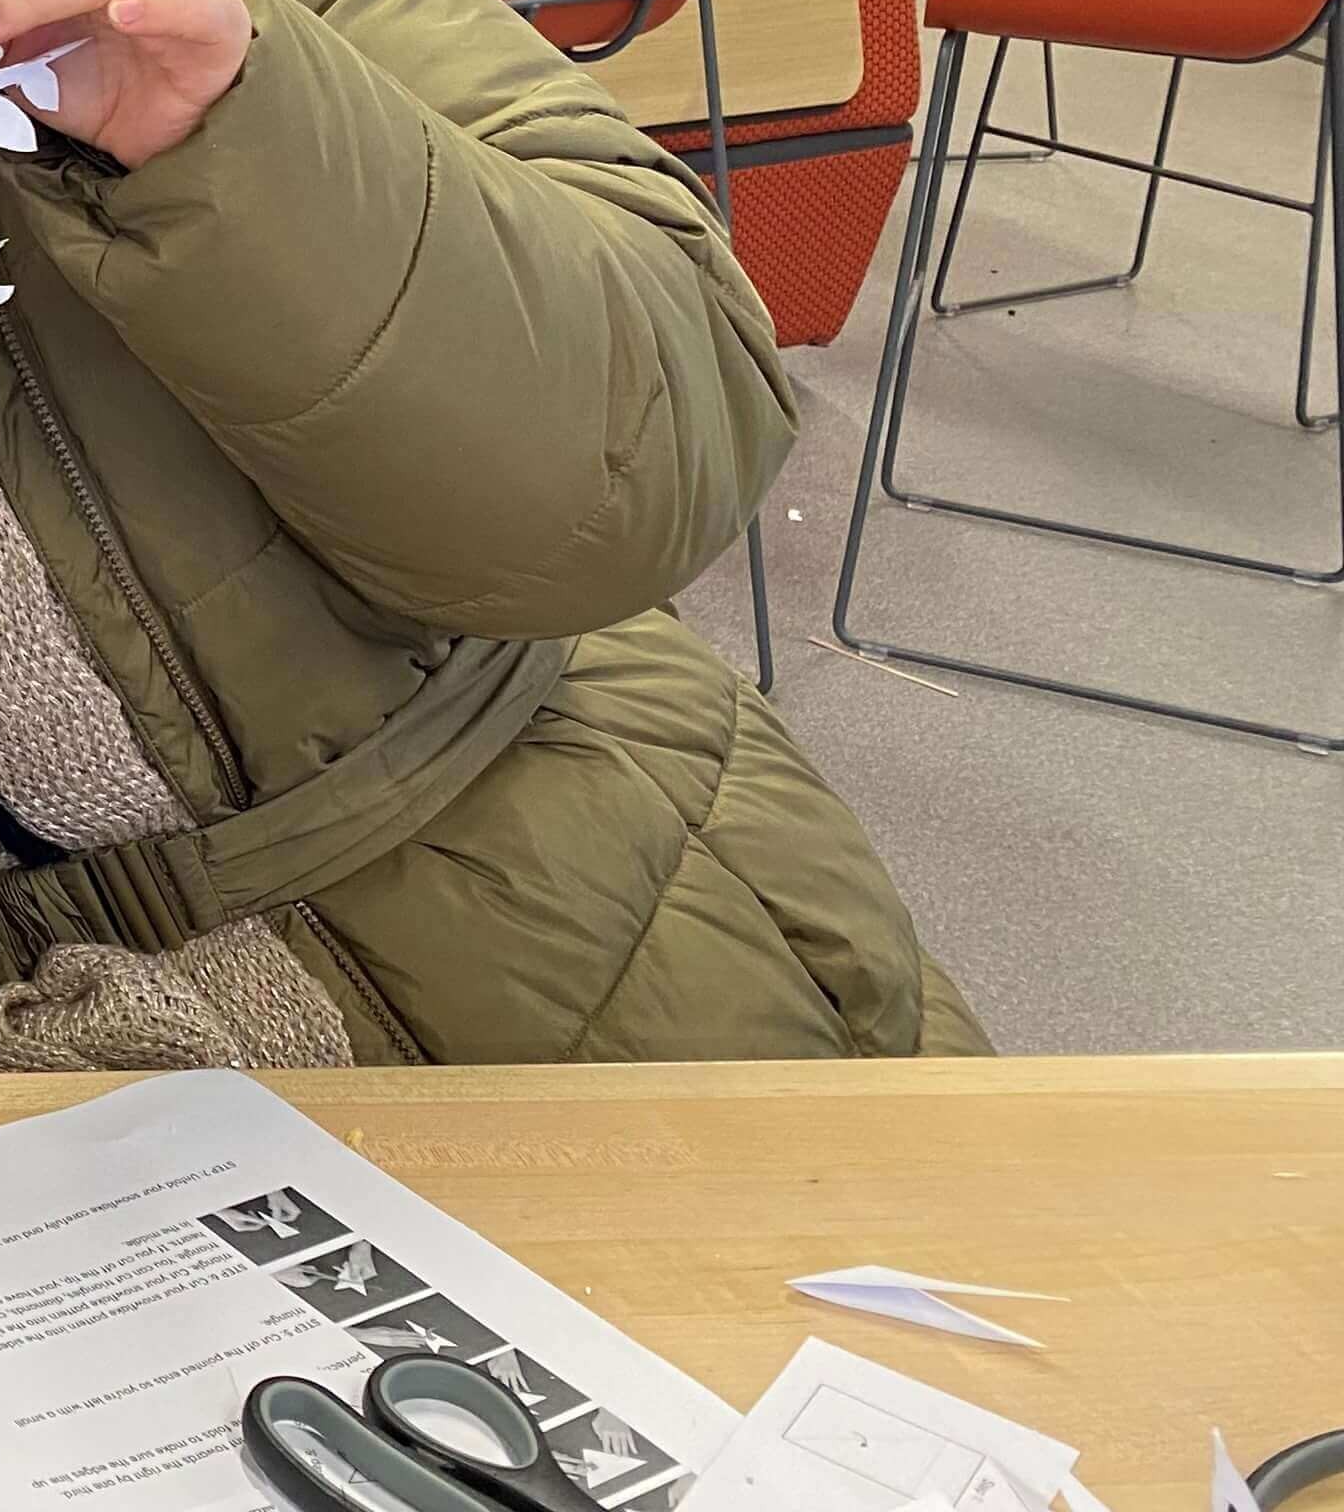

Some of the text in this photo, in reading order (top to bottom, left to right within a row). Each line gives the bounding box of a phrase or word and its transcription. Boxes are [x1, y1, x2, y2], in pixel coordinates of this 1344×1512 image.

[211, 1160, 237, 1174] STEP
[165, 1173, 201, 1189] Unfold
[142, 1183, 164, 1196] your
[90, 1193, 141, 1213] snowflake
[44, 1210, 90, 1230] carefully
[1, 1234, 22, 1244] use
[23, 1226, 44, 1239] and
[121, 1220, 194, 1247] in the middle.
[135, 1246, 156, 1259] you
[175, 1241, 220, 1260] triangle.
[117, 1255, 135, 1267] cut
[153, 1257, 177, 1268] You
[79, 1268, 101, 1279] the
[100, 1262, 117, 1274] off
[132, 1264, 154, 1276] can
[169, 1268, 190, 1280] Cut
[221, 1263, 248, 1278] STEP
[58, 1275, 81, 1285] tip,
[114, 1272, 133, 1284] cut
[145, 1273, 168, 1288] your
[188, 1277, 209, 1289] Cut
[31, 1280, 58, 1296] you'll
[62, 1279, 115, 1299] triangles,
[163, 1283, 189, 1298] your
[4, 1290, 32, 1302] have
[90, 1285, 144, 1307] snowflake
[6, 1295, 64, 1315] diamonds,
[50, 1301, 90, 1320] pattern
[108, 1294, 162, 1316] snowflake
[25, 1315, 51, 1326] into
[67, 1311, 108, 1330] pattern
[260, 1307, 306, 1326] triangle.
[5, 1322, 27, 1332] the
[44, 1326, 68, 1337] into
[294, 1318, 321, 1334] STEP
[25, 1332, 46, 1342] the
[260, 1333, 282, 1345] Cut
[223, 1347, 245, 1358] the
[243, 1340, 260, 1353] off
[180, 1352, 224, 1376] pointed
[153, 1371, 181, 1385] ends
[138, 1381, 153, 1390] so
[103, 1384, 137, 1401] you're
[82, 1396, 104, 1409] left
[45, 1410, 57, 1418] a
[56, 1403, 82, 1416] with
[14, 1413, 46, 1428] small
[201, 1424, 233, 1438] folds
[187, 1435, 203, 1444] to
[155, 1439, 188, 1454] make
[108, 1458, 131, 1468] the
[128, 1450, 156, 1463] sure
[60, 1444, 230, 1500] towards the right by one third.
[71, 1464, 108, 1478] edges
[31, 1479, 49, 1489] up
[49, 1473, 73, 1484] line
